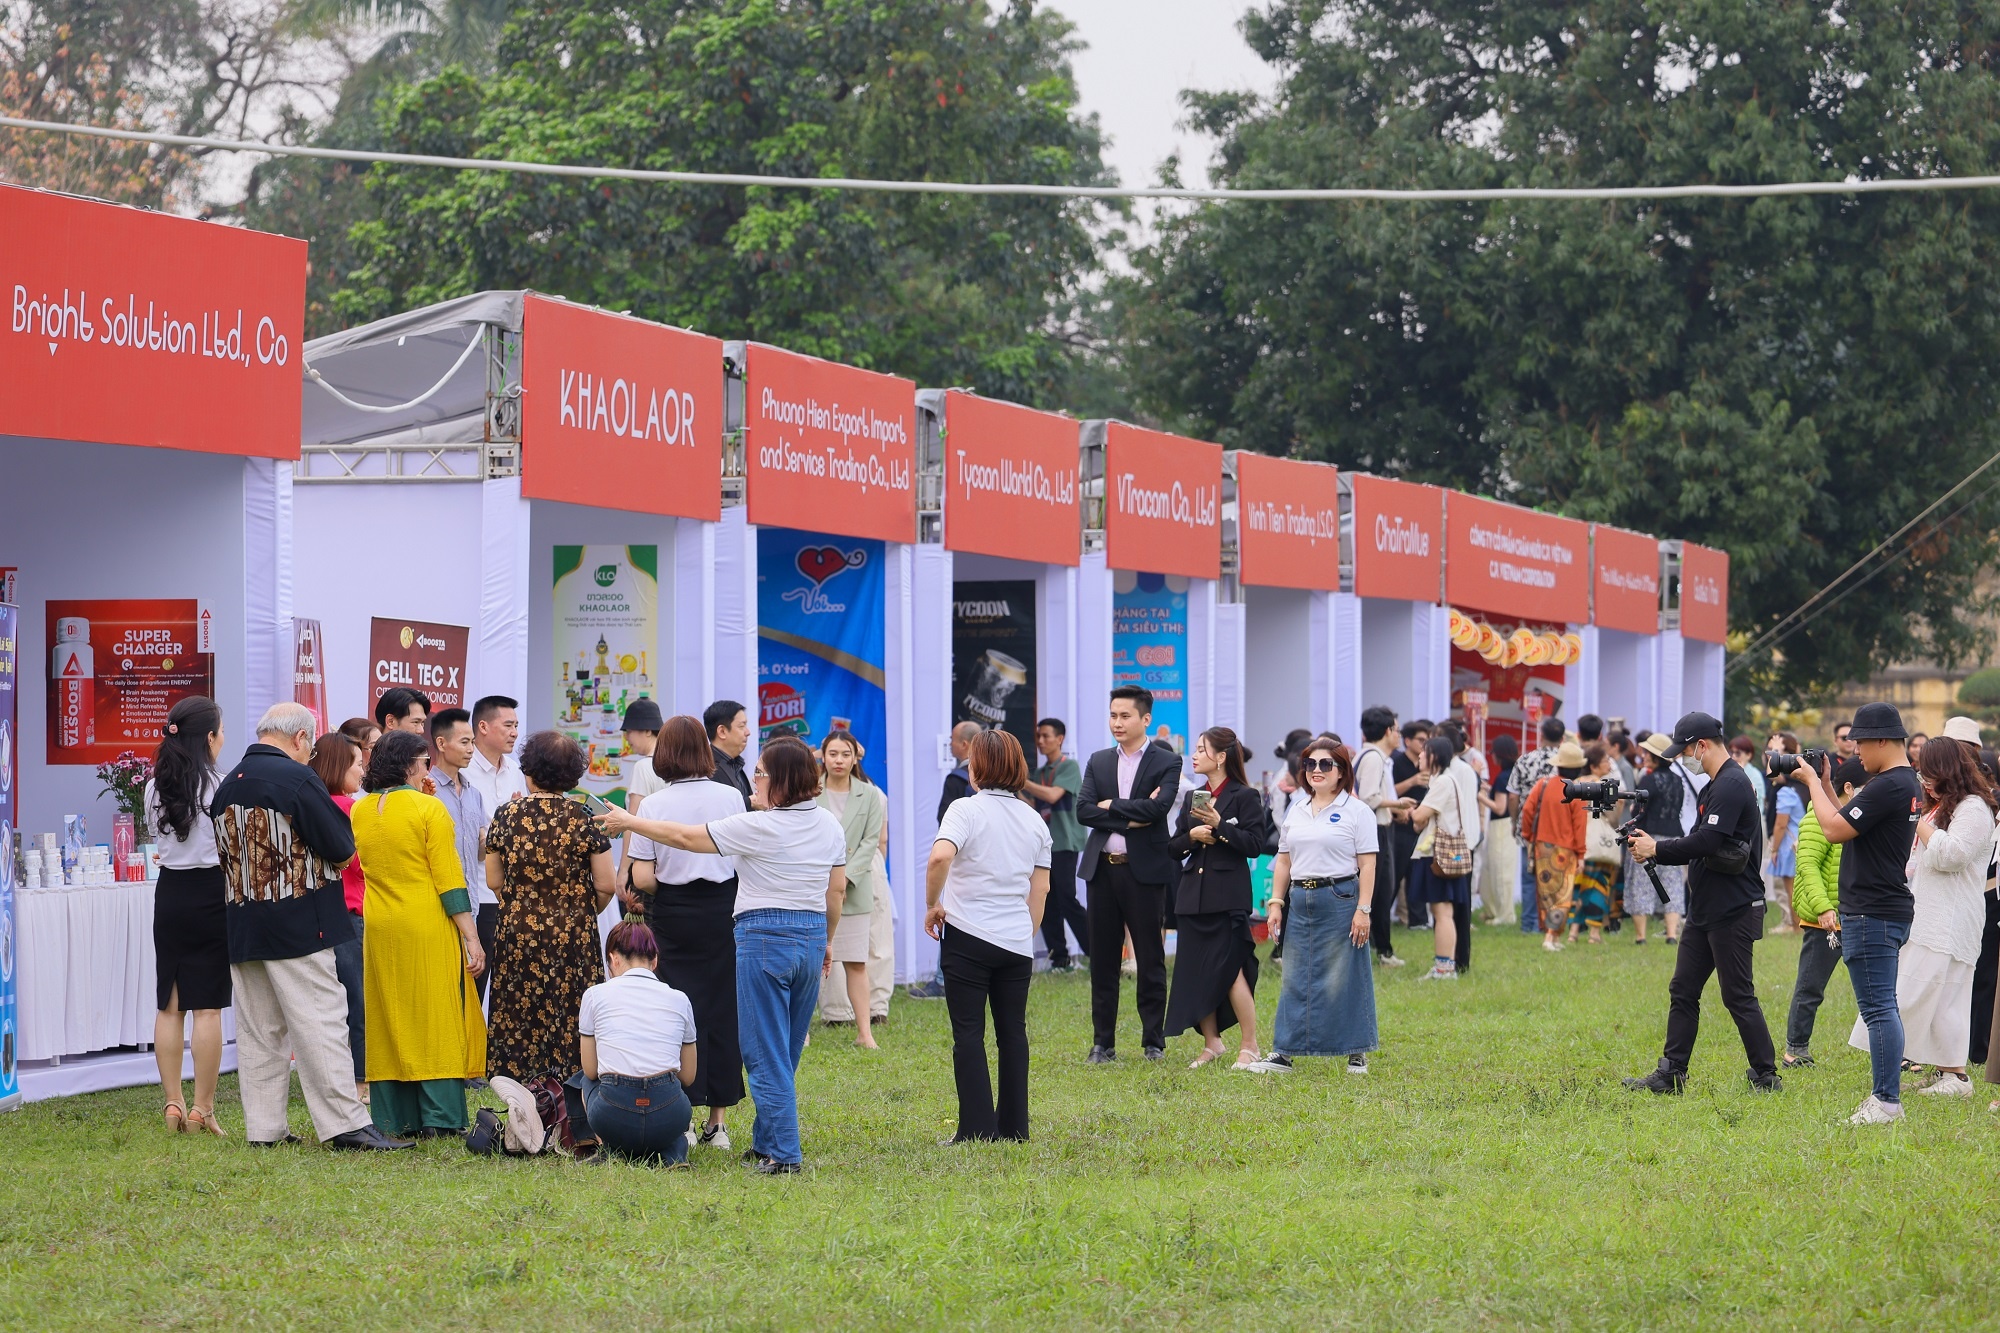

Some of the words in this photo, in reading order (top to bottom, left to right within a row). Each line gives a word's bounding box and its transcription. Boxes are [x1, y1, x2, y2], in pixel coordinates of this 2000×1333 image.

[12, 285, 94, 356] Bright
[100, 293, 196, 355] Solution
[202, 309, 250, 367] Ltd.,
[256, 316, 288, 366] Co
[560, 368, 695, 448] KHAOLAOR
[762, 386, 805, 437] Phuong
[806, 398, 831, 430] Hien
[832, 403, 869, 446] Export
[871, 408, 907, 453] Import
[760, 436, 783, 471] and
[784, 441, 826, 478] Service
[826, 447, 868, 495] Trading
[868, 454, 889, 491] Co.,
[890, 458, 909, 490] Ltd
[956, 449, 999, 501] Tycoon
[1000, 458, 1032, 498] World
[1034, 464, 1054, 506] Co.,
[1055, 469, 1074, 505] Ltd
[1117, 472, 1170, 520] VTracom
[1171, 480, 1194, 528] Co.,
[1195, 484, 1216, 527] Ltd
[1247, 501, 1266, 531] Vinh
[1266, 502, 1285, 533] Tien
[1285, 503, 1316, 547] Trading
[1375, 513, 1430, 557] ChaTraMue
[579, 604, 630, 612] KHAOLAOR
[1150, 607, 1170, 620] TẠI
[124, 630, 171, 642] SUPER
[1132, 620, 1158, 633] SIÊU
[113, 643, 183, 655] CHARGER
[423, 637, 446, 648] BOOSTA
[1136, 645, 1175, 667] GO!
[375, 659, 413, 684] CELL
[418, 663, 444, 687] TEC
[447, 667, 459, 688] X
[772, 662, 809, 675] O'tori
[1145, 671, 1179, 683] GS25
[68, 680, 78, 746] BOOSTA
[963, 693, 1006, 722] TYCOON
